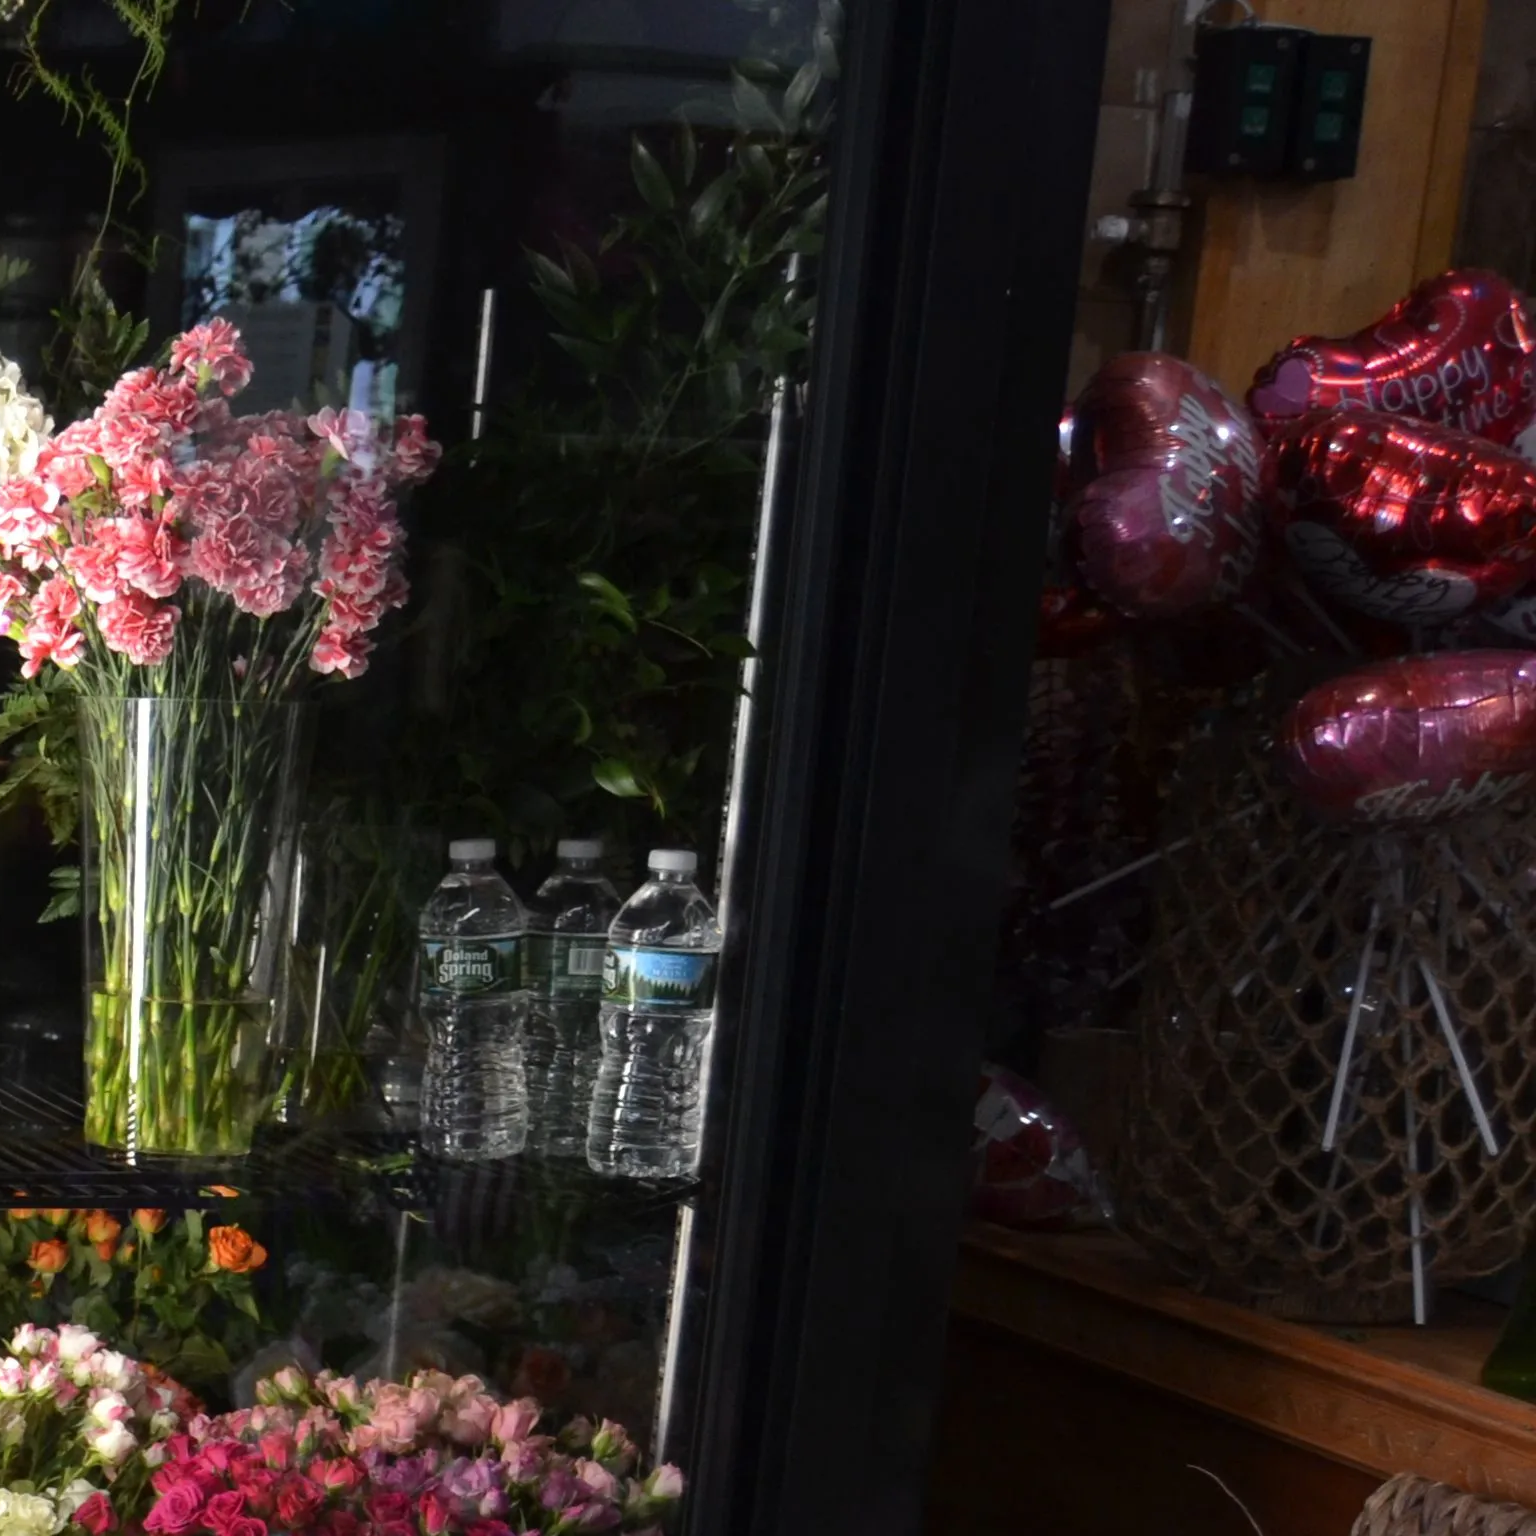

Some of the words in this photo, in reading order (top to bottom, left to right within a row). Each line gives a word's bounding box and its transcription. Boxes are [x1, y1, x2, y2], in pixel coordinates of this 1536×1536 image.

[1330, 345, 1489, 415] Happy
[1441, 366, 1536, 433] tine's
[1158, 394, 1229, 548] Happy
[443, 949, 488, 963] Poland
